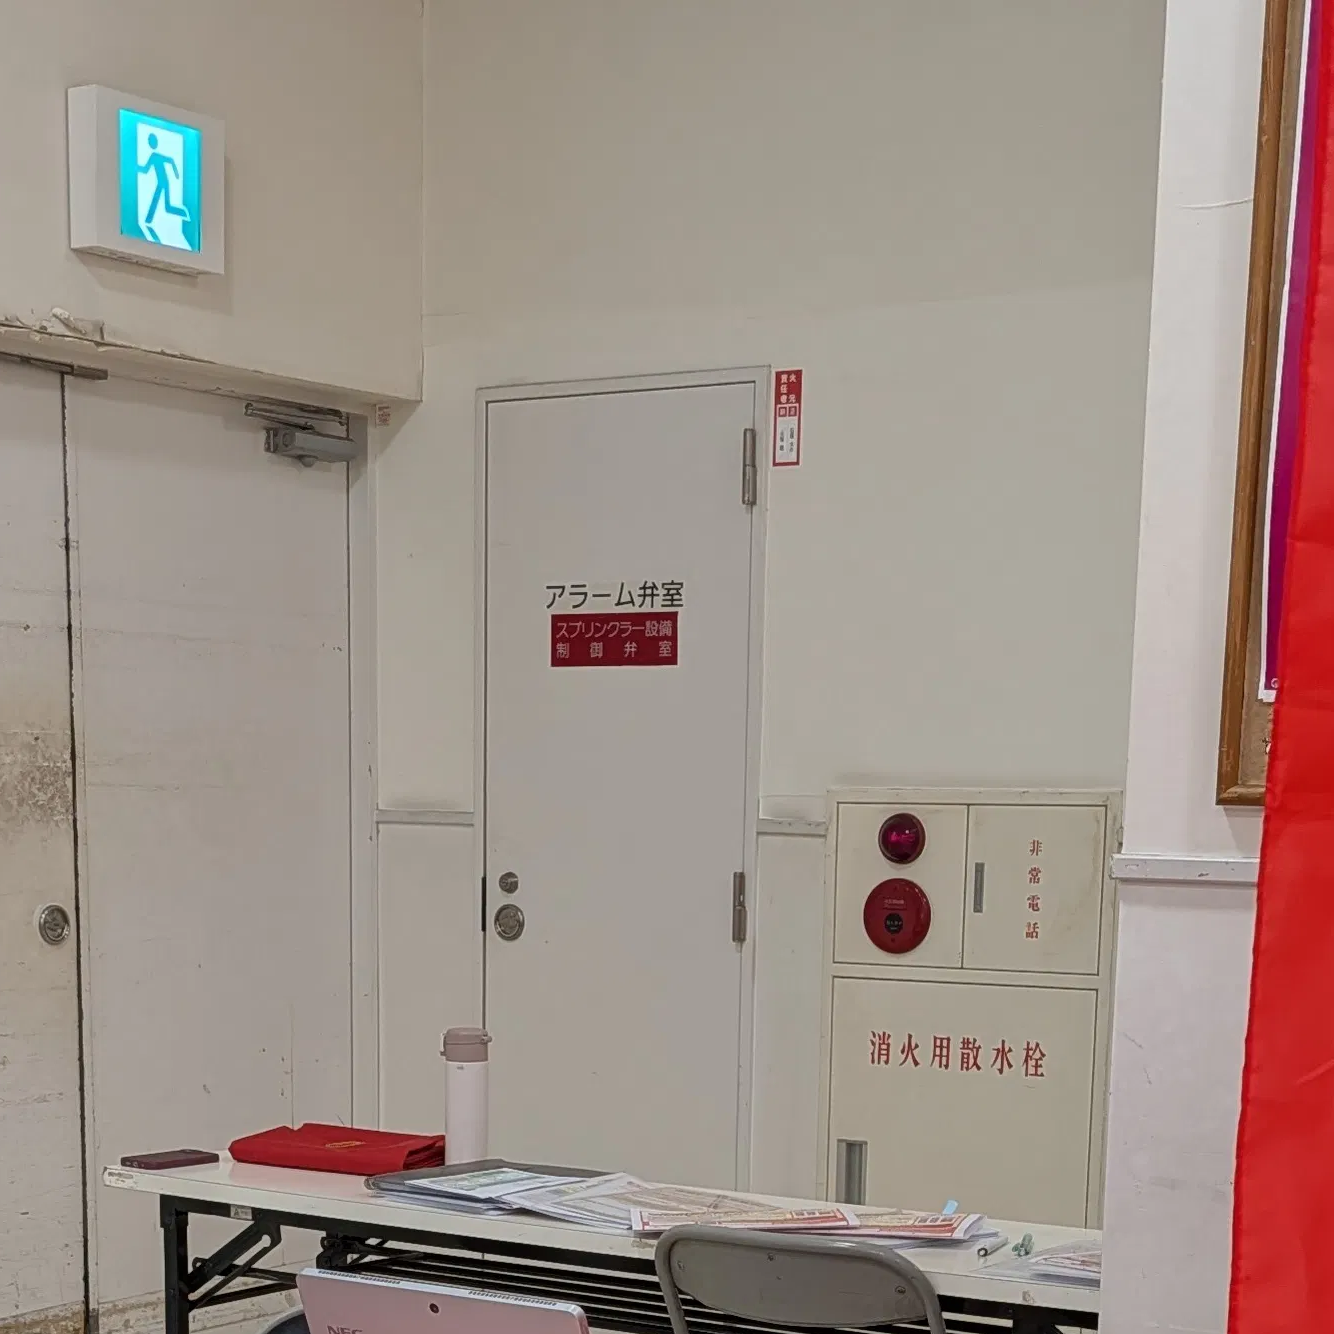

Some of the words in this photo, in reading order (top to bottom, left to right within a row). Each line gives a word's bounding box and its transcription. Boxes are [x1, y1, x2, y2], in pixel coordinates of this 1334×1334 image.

[546, 580, 684, 609] アラーム弁室
[556, 620, 673, 638] スプリンクラー設備
[556, 641, 672, 658] 制御弁室
[1025, 839, 1043, 940] 非常電話
[869, 1030, 1047, 1078] 消火用散水栓
